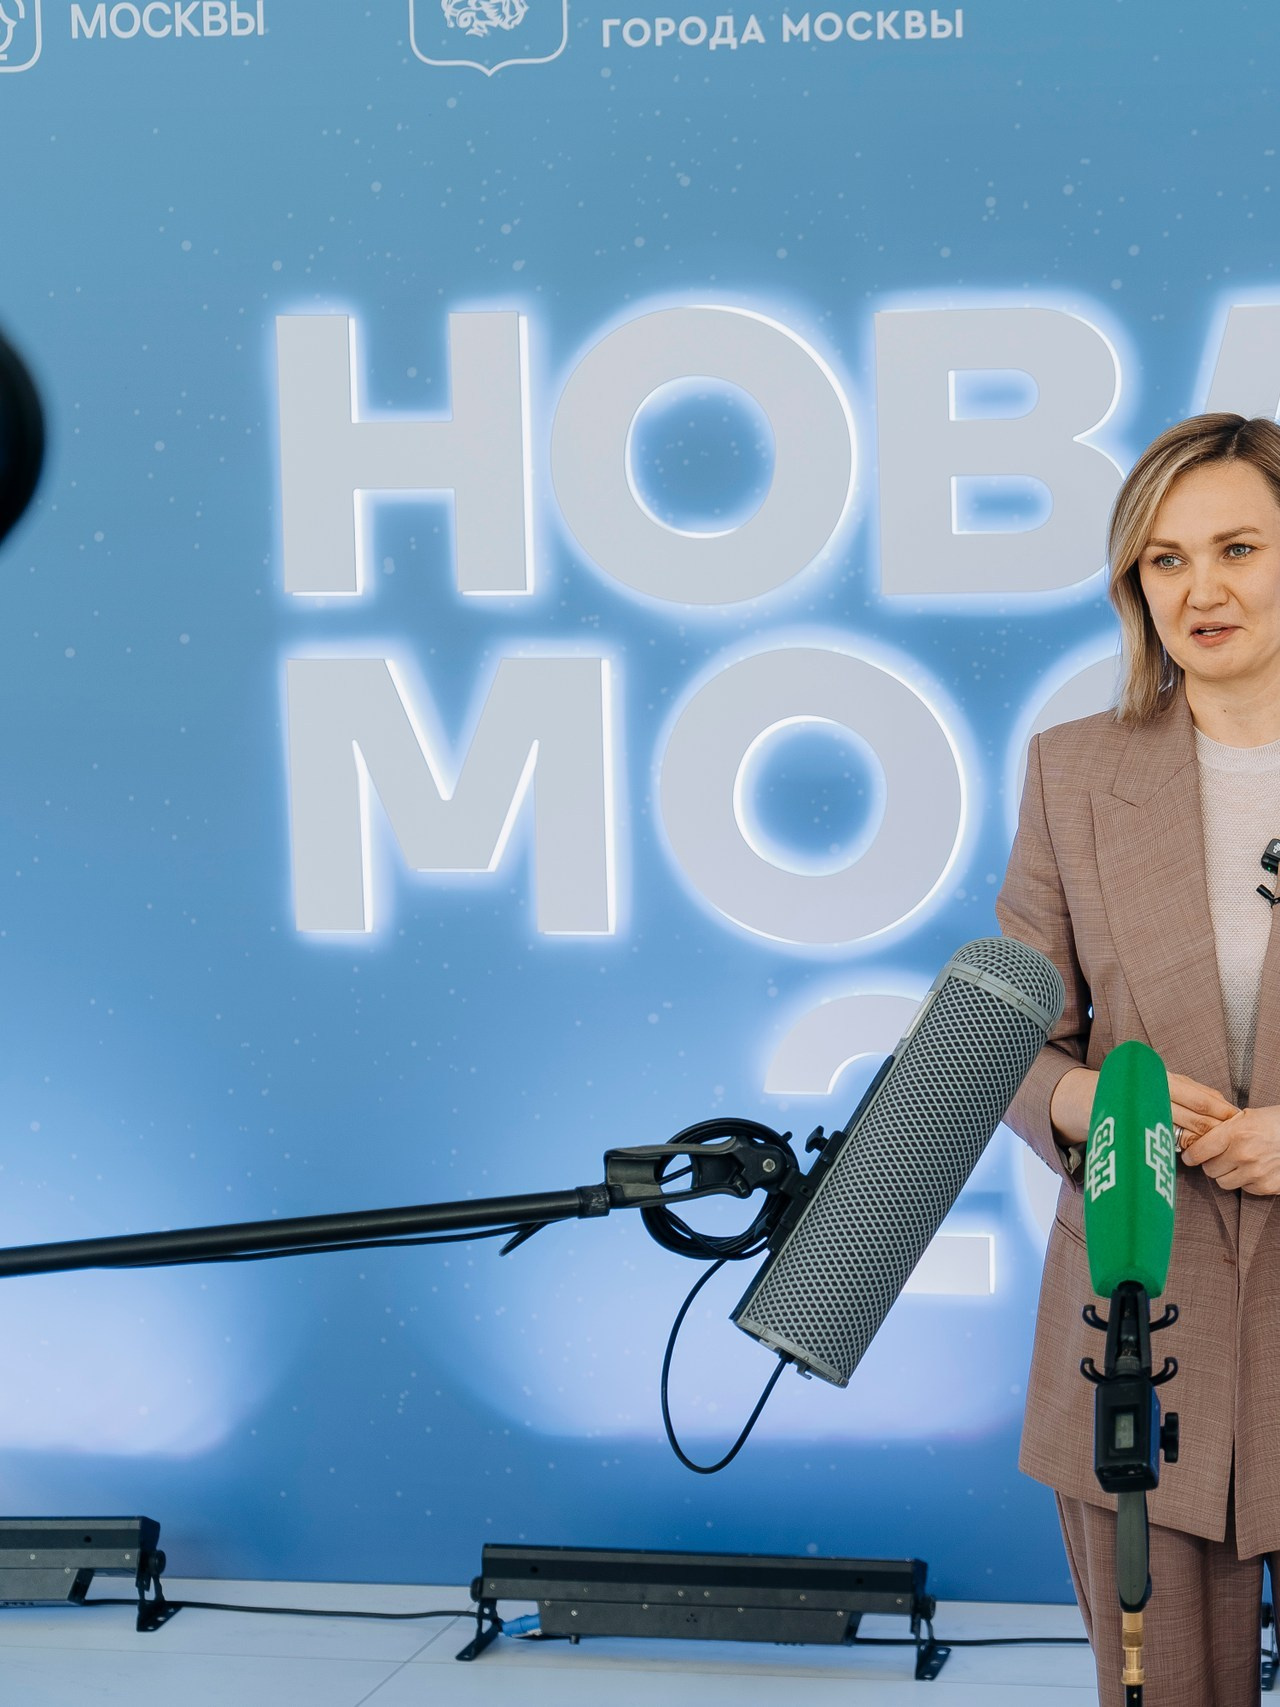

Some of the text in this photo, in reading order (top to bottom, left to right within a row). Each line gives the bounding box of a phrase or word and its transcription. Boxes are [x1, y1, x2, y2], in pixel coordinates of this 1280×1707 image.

[70, 0, 265, 39] МОСКВЫ
[602, 9, 964, 50] ГОРОДА МОСКВЫ
[1145, 1122, 1175, 1208] НТВ
